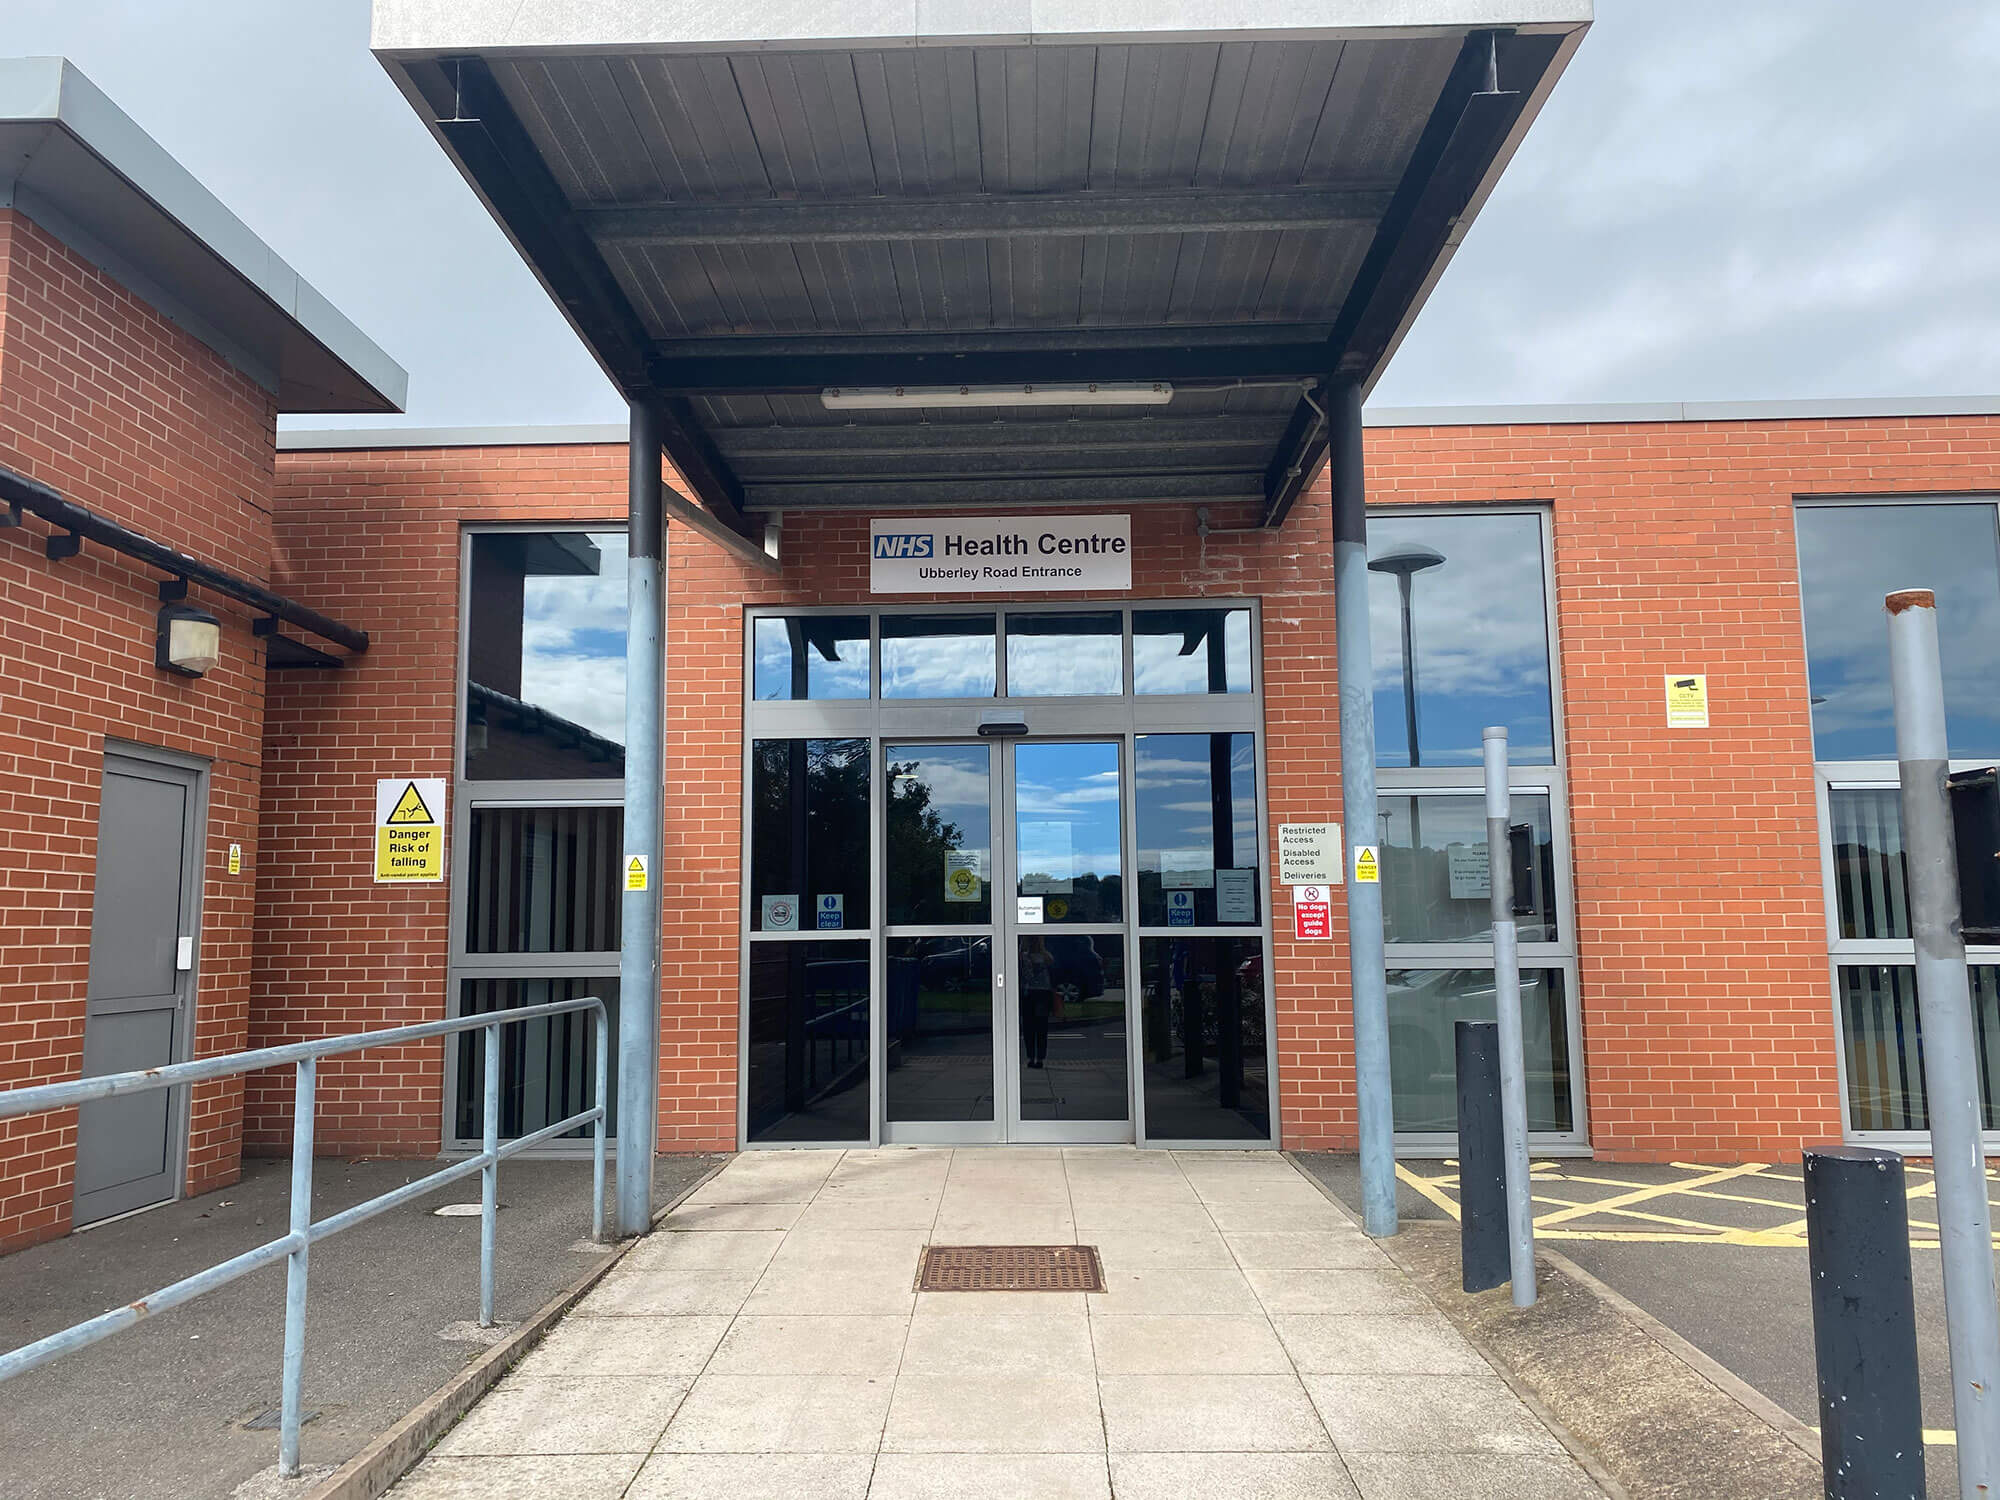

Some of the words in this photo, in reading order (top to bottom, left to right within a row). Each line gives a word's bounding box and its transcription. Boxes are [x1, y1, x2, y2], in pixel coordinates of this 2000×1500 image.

[875, 535, 933, 558] NHS
[945, 534, 1028, 556] Health
[1037, 533, 1126, 554] Centre
[919, 567, 978, 580] Ubberley
[983, 566, 1018, 578] Road
[1022, 566, 1082, 577] Entrance
[389, 830, 430, 841] Danger
[1283, 836, 1314, 844] Access
[389, 843, 414, 853] Risk
[418, 843, 429, 852] of
[1283, 849, 1320, 857] Disabled
[391, 857, 426, 868] falling
[1284, 858, 1315, 866] Access
[1284, 871, 1327, 879] Deliveries
[1309, 903, 1327, 911] dogs
[820, 912, 840, 920] Keep
[820, 920, 839, 928] clear
[1304, 928, 1322, 936] dogs
